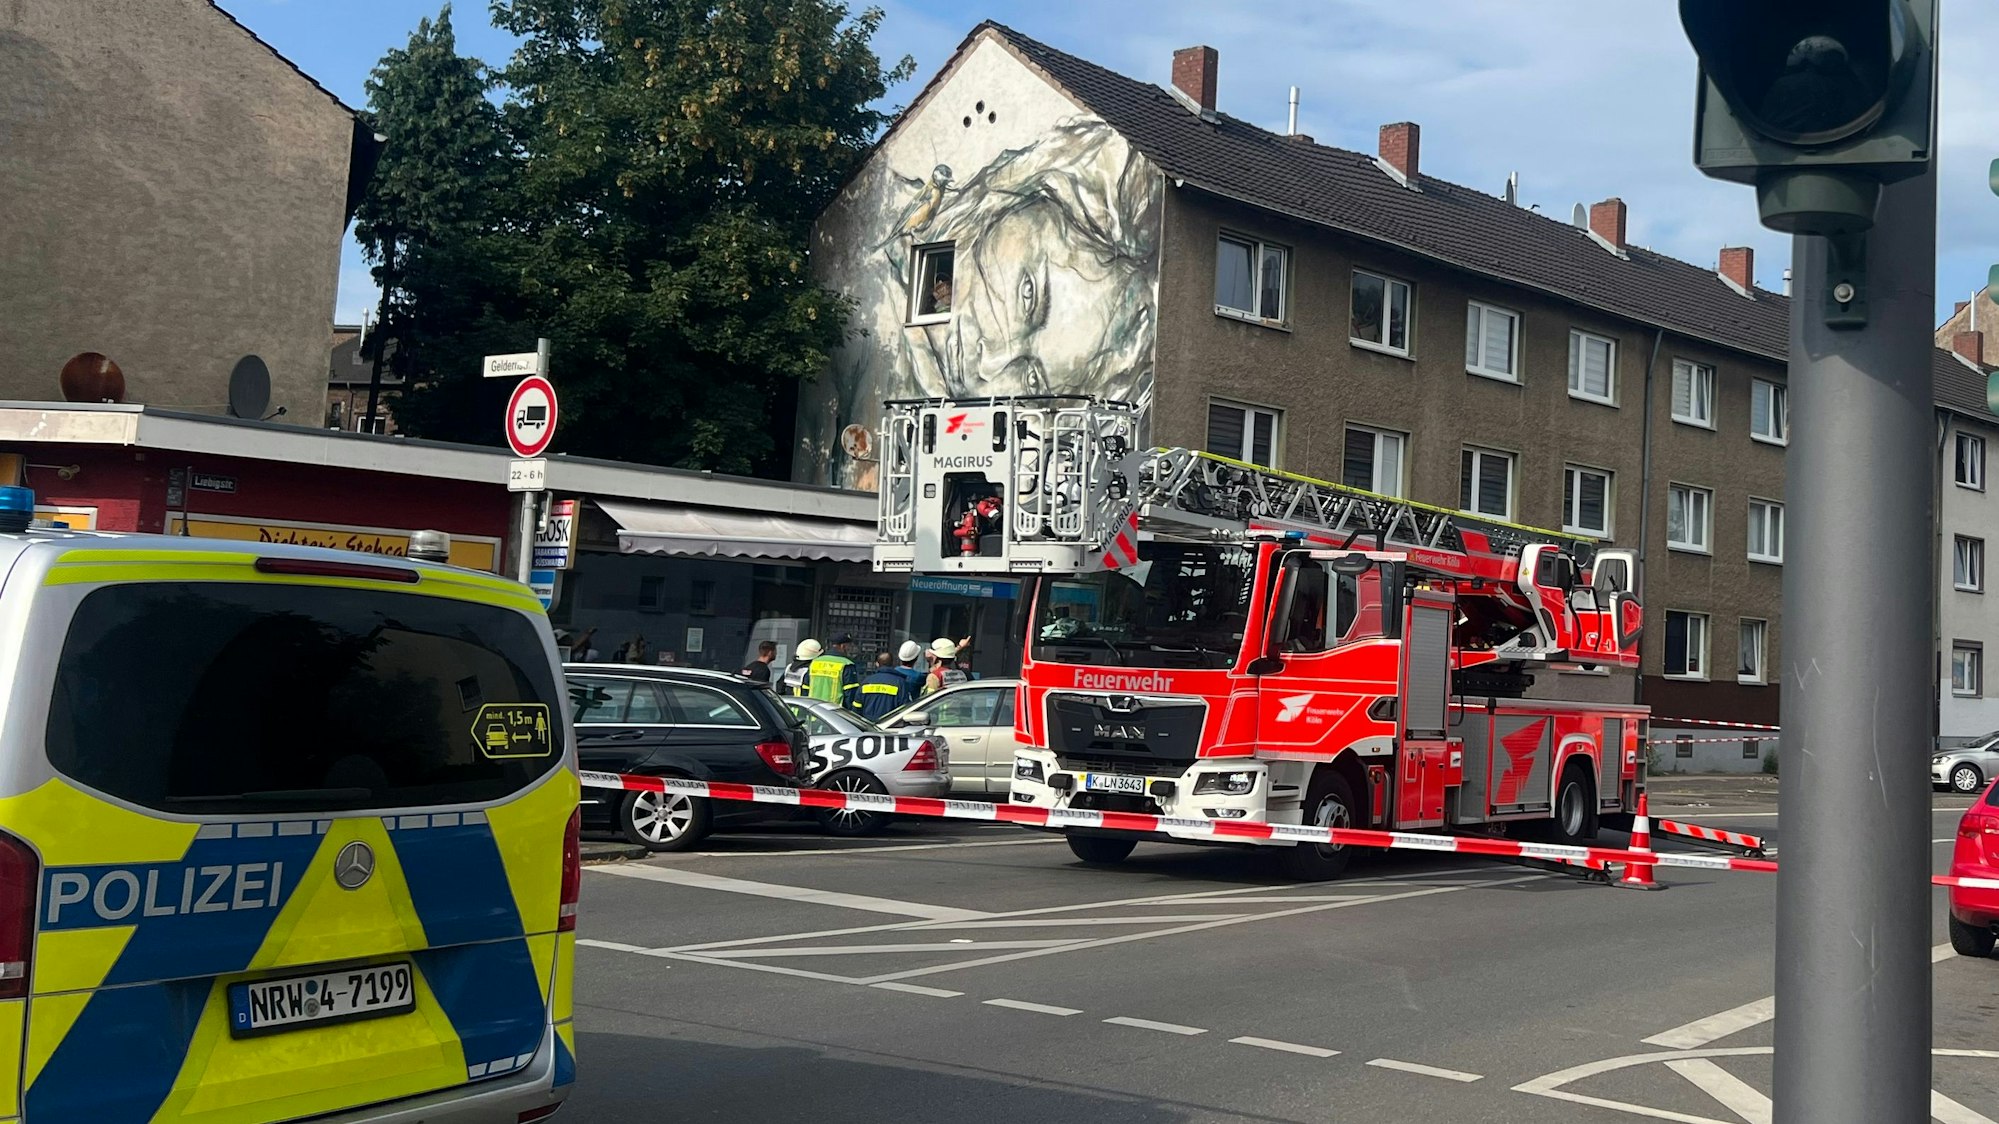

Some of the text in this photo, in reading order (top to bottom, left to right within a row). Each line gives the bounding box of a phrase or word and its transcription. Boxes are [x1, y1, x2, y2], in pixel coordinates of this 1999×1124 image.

[933, 455, 993, 469] MAGIRUS
[511, 470, 522, 480] 22
[529, 470, 535, 479] 6
[537, 470, 543, 479] h
[1101, 500, 1134, 551] MAGIRUS
[1415, 550, 1460, 568] Feuerwehr Köln
[911, 578, 968, 594] Neueröffnung
[1073, 668, 1174, 692] Feuerwehr
[485, 711, 505, 720] mind.
[1306, 706, 1344, 716] Feuerwehr
[1305, 715, 1323, 724] Köln
[1093, 723, 1146, 740] MAN
[1092, 776, 1100, 786] K
[47, 861, 283, 923] POLIZEI
[238, 968, 409, 1023] D NRW 4-7199
